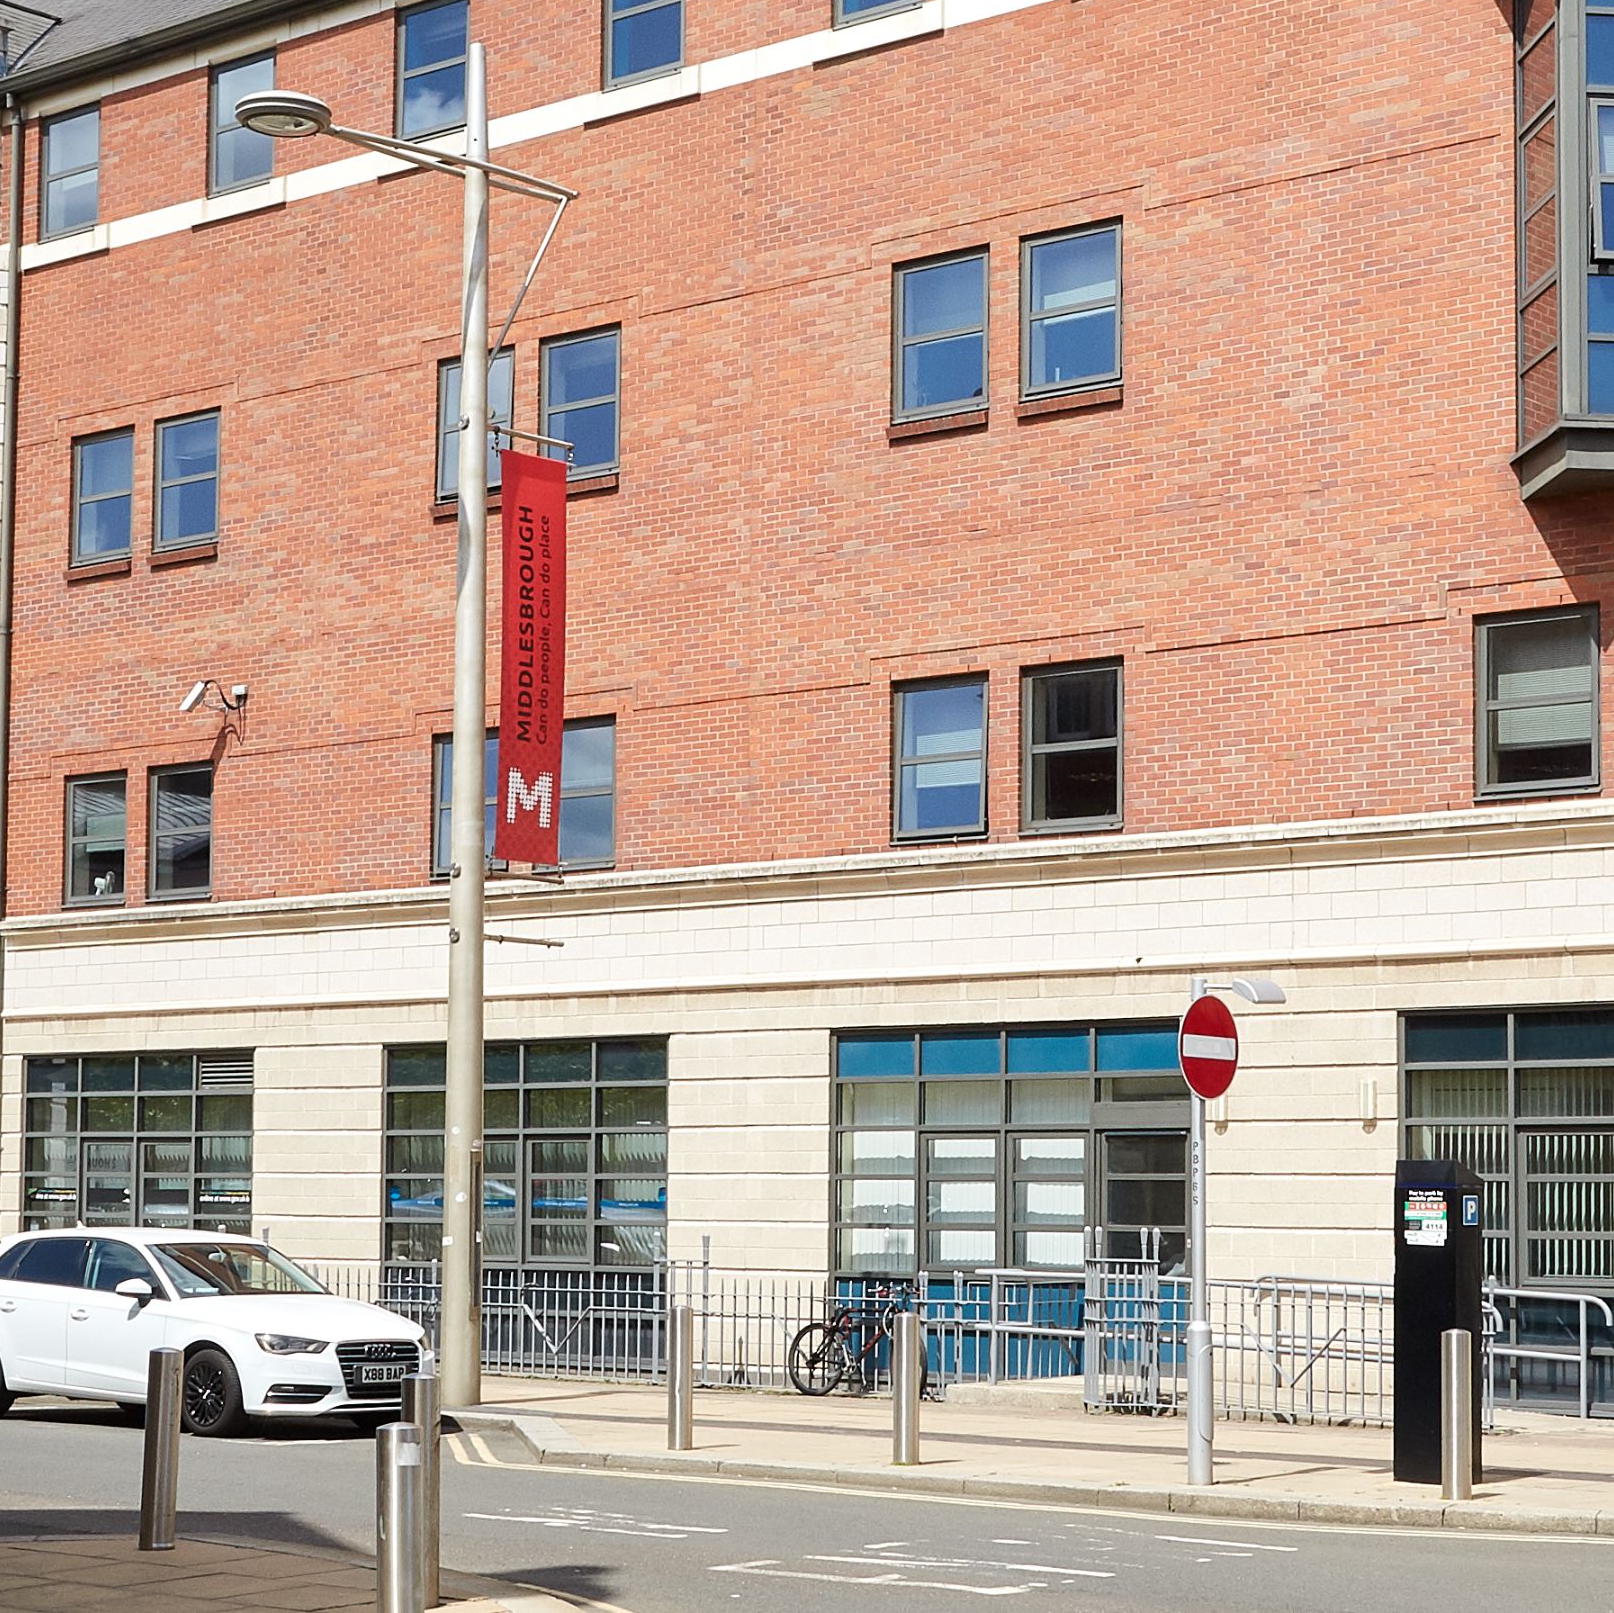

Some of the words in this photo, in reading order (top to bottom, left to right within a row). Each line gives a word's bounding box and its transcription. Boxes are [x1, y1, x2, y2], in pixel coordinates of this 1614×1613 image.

[540, 515, 553, 555] place
[540, 559, 550, 583] do
[539, 589, 551, 618] Can
[517, 506, 534, 743] MIDDLESBROUGH
[539, 621, 553, 677] people,
[538, 682, 549, 709] do
[536, 713, 548, 745] Can
[506, 767, 553, 828] M
[1467, 1201, 1476, 1220] P
[364, 1367, 384, 1381] X88
